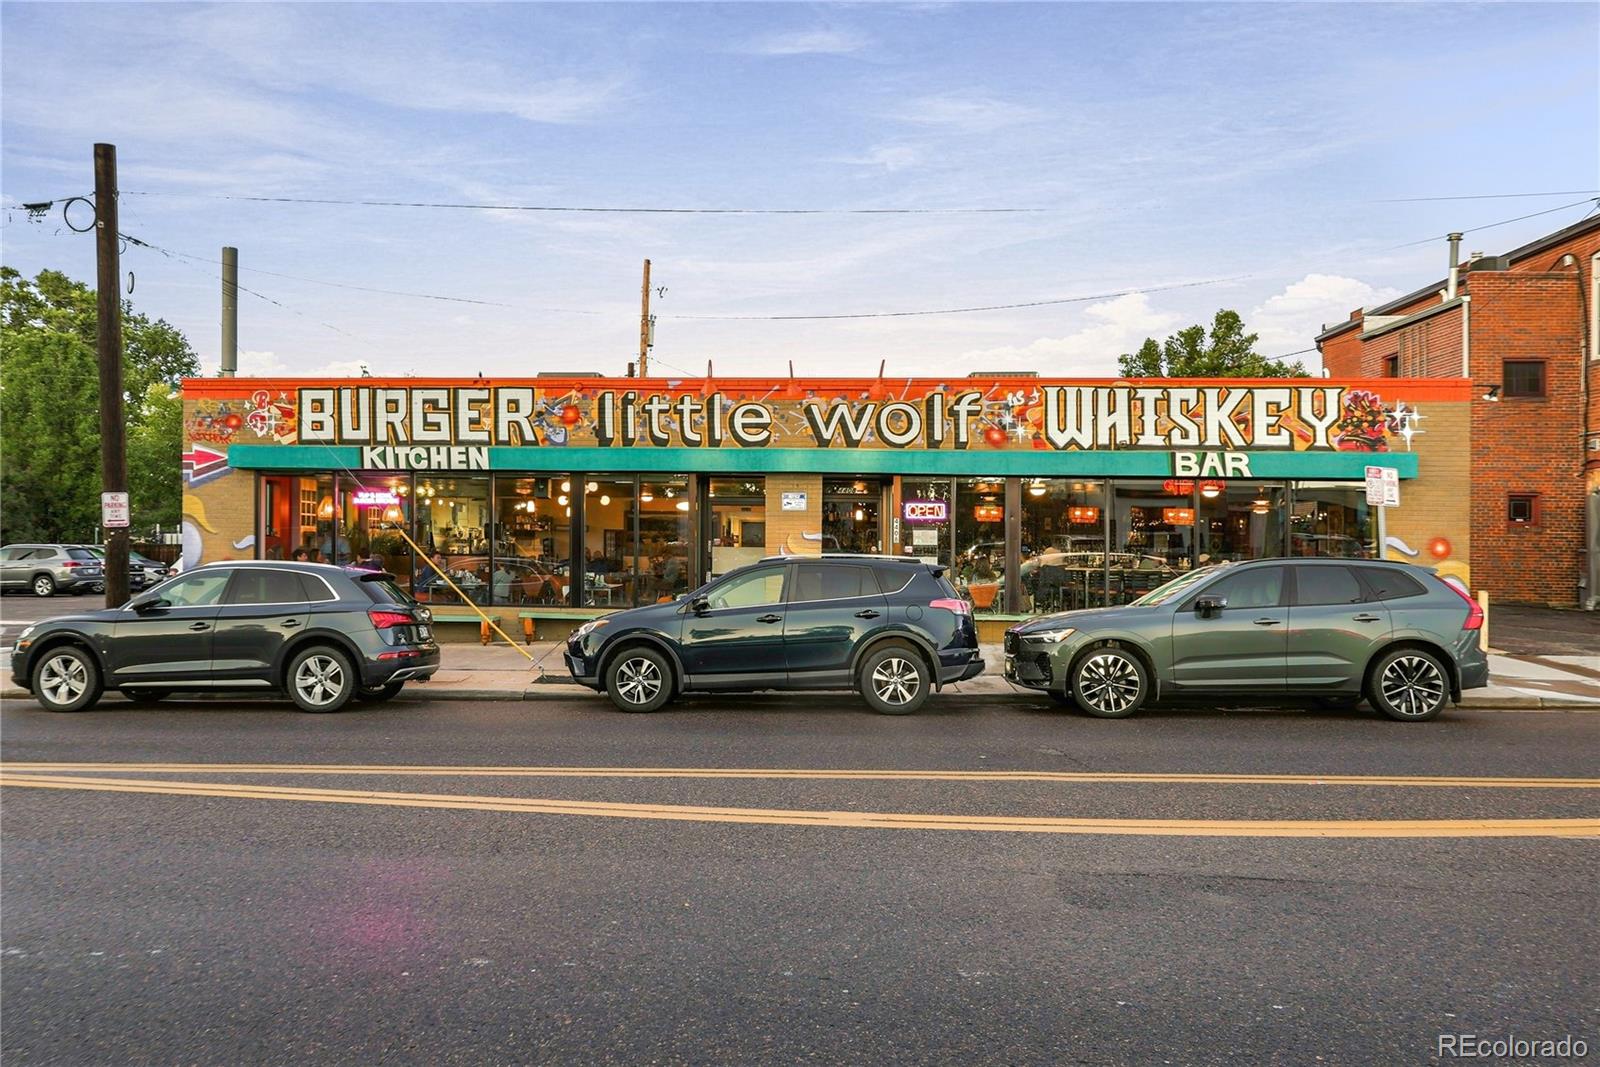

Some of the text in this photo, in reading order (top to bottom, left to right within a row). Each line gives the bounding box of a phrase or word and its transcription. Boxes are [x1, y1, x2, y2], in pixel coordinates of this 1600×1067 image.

[297, 388, 540, 445] BURGER
[599, 391, 982, 449] little wolf
[1043, 386, 1341, 450] WHISKEY
[362, 446, 490, 470] KITCHEN
[1174, 451, 1252, 477] BAR
[908, 505, 943, 516] OPEN
